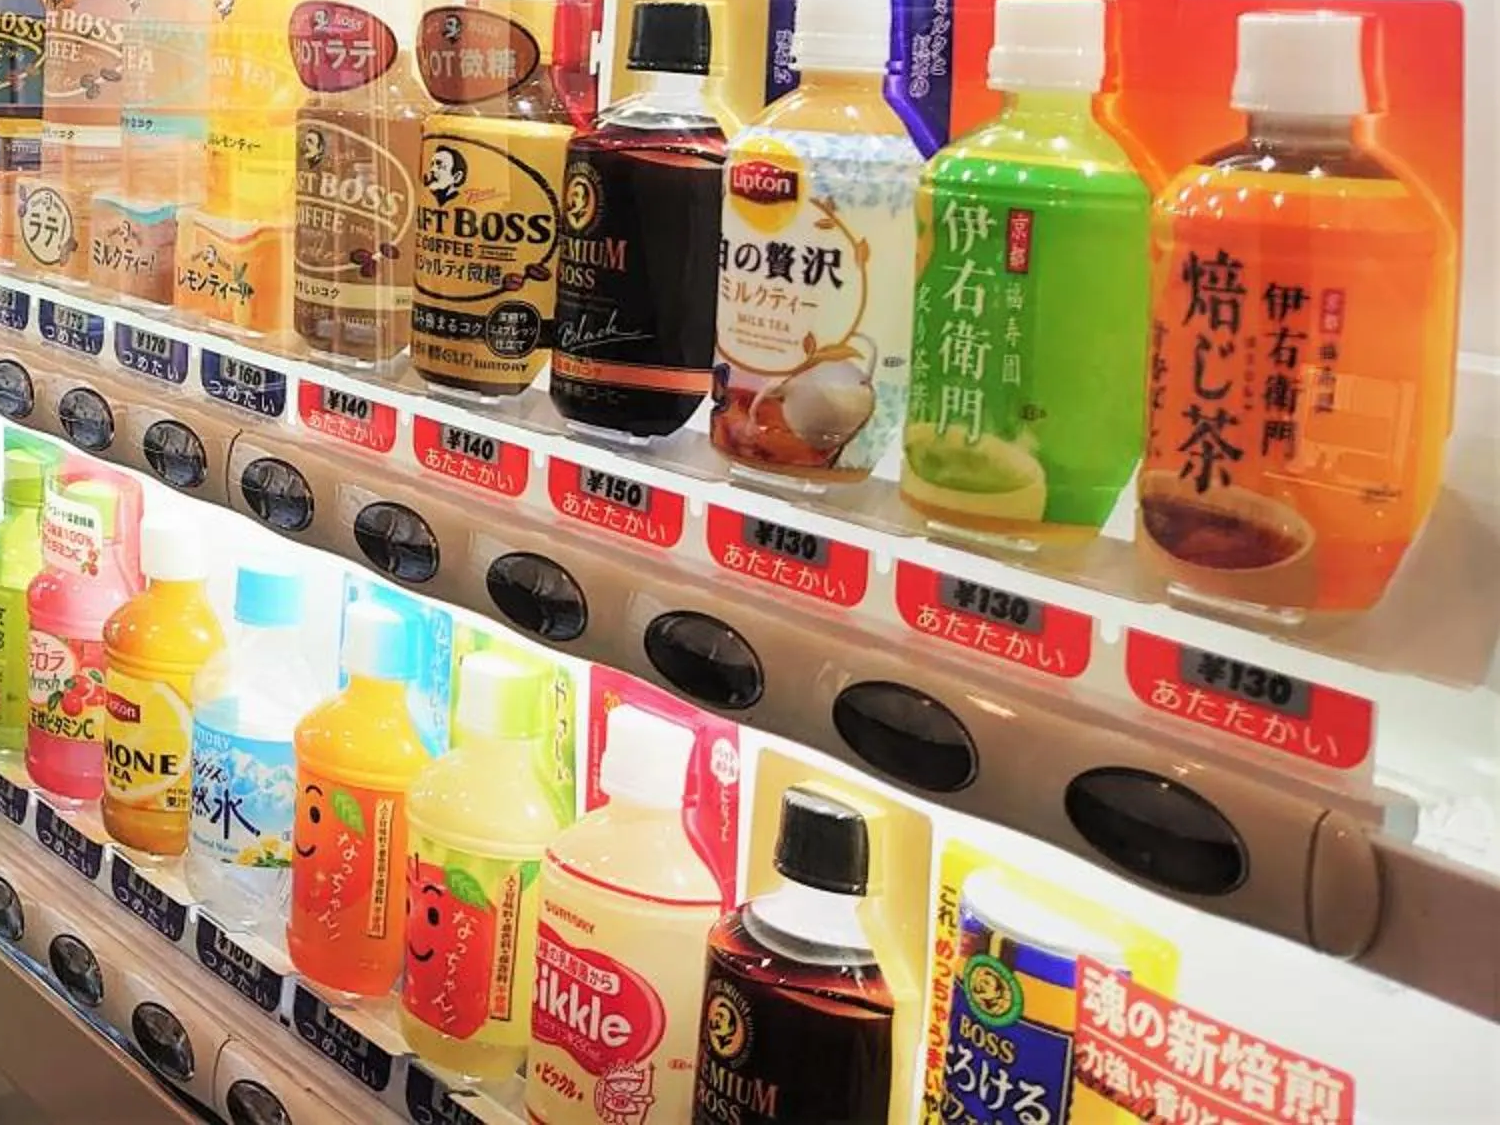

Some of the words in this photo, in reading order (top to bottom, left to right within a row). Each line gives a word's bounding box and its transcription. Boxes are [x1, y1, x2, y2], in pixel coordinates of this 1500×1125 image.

[62, 10, 126, 47] BOSS
[326, 38, 377, 70] ラテ
[459, 47, 518, 79] 微糖
[318, 172, 406, 219] BOSS
[731, 167, 792, 195] Lipton
[453, 211, 554, 246] BOSS
[1008, 212, 1032, 269] 京都
[720, 275, 820, 316] ミルクティー
[44, 323, 99, 354] つめたい
[134, 329, 168, 357] ¥170
[937, 197, 998, 445] 伊右衛門
[120, 347, 182, 383] つめたい
[224, 355, 264, 387] ¥160
[1177, 247, 1250, 495] 焙じ茶
[1259, 281, 1312, 459] 伊右衛門
[208, 377, 279, 415] つめたい
[326, 387, 369, 420] ¥140
[307, 408, 388, 449] あたたかい
[445, 427, 495, 462] ¥140
[422, 445, 517, 493] あたたかい
[583, 468, 643, 508] ¥150
[560, 490, 669, 542] あたたかい
[752, 518, 819, 563] ¥130
[723, 540, 850, 601] あたたかい
[949, 574, 1031, 627] ¥130
[914, 604, 1069, 673] あたたかい
[1196, 654, 1293, 707] ¥130
[1150, 679, 1340, 760] あたたかい
[39, 829, 100, 883] つめたい
[118, 887, 178, 938] つめたい
[203, 949, 270, 1011] つめたい
[430, 908, 480, 1029] なっちゃん
[532, 963, 633, 1049] ikkle
[303, 1021, 377, 1083] つめたい
[959, 1015, 1018, 1065] BOSS
